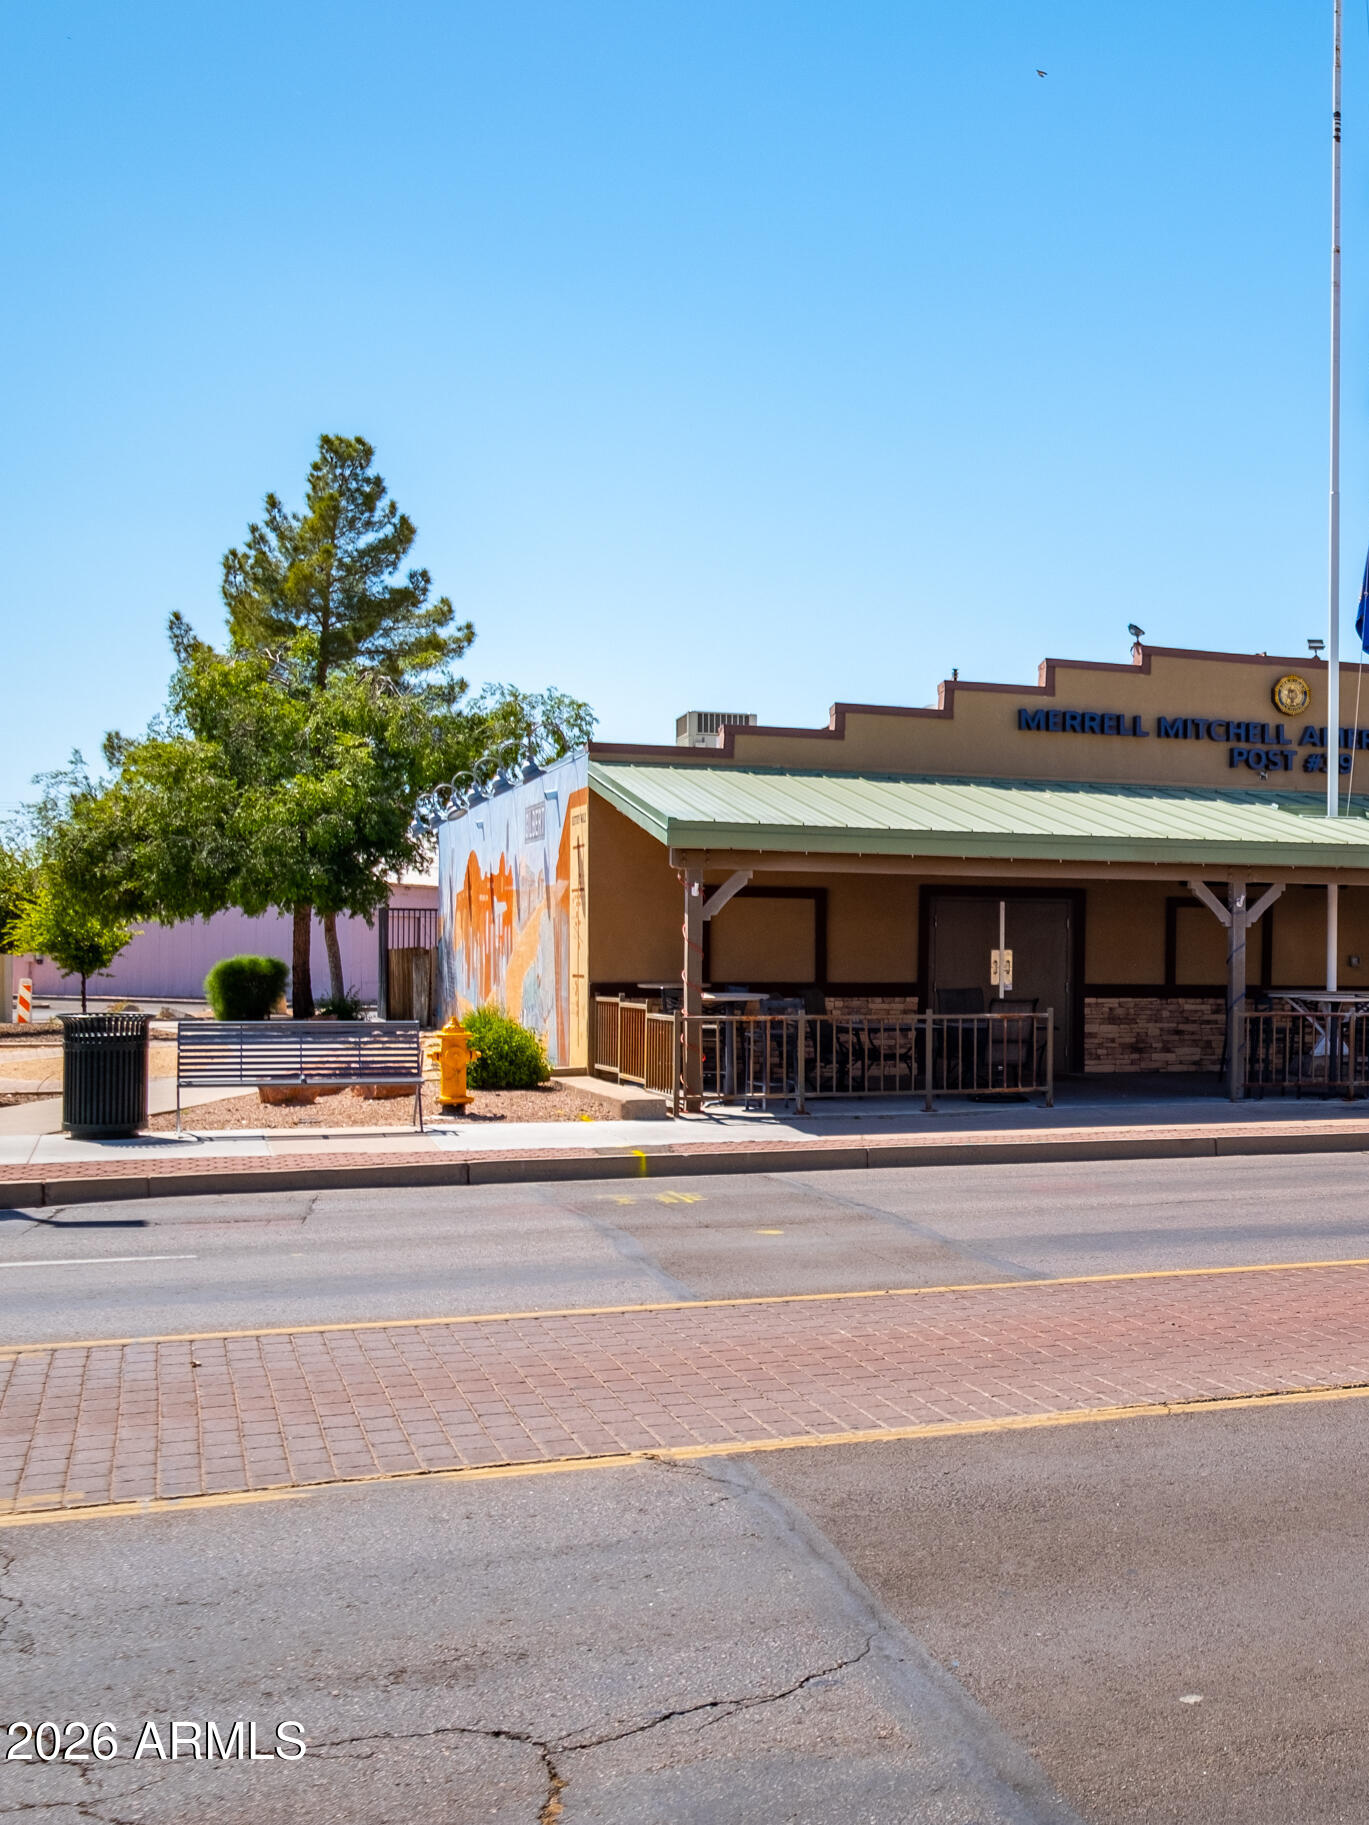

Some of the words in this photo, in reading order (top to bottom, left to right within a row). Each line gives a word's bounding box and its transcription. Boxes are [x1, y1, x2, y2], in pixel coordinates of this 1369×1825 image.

[1018, 708, 1149, 737] MERRELL
[1157, 716, 1292, 745] MITCHELL
[1229, 747, 1297, 771] POST
